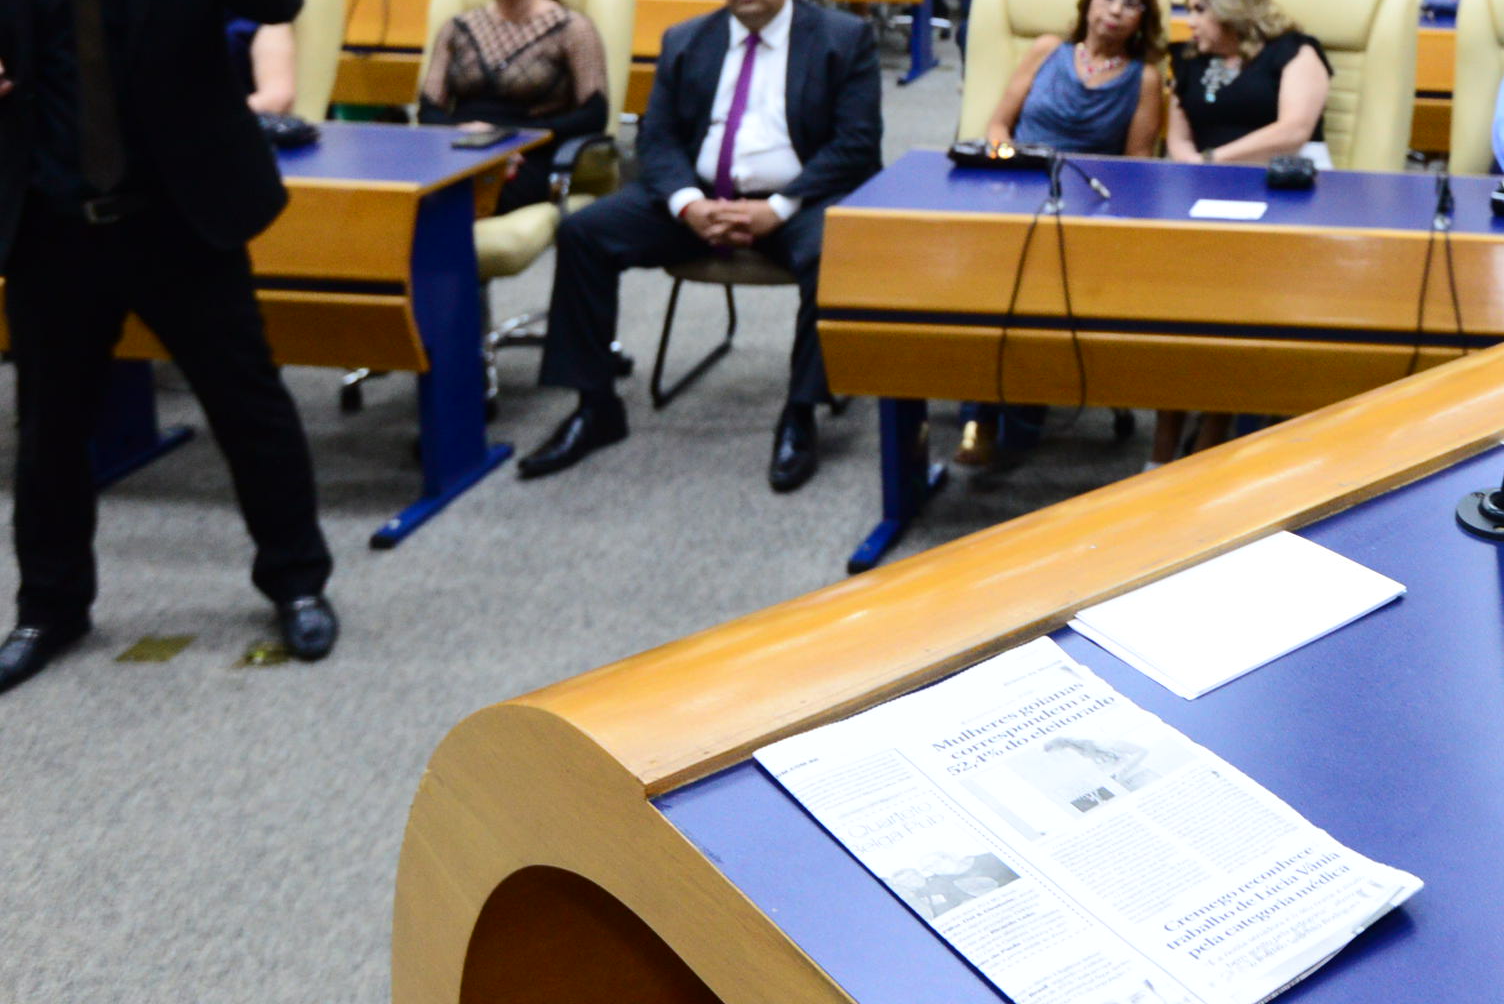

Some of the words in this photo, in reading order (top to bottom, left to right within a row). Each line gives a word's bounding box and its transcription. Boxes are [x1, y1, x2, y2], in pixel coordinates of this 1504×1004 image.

[932, 711, 1018, 753] Mulheres
[1018, 682, 1085, 717] goianas
[946, 747, 1005, 776] 52,4%
[1005, 735, 1030, 752] do
[1029, 694, 1115, 740] eleitorado
[951, 697, 1078, 760] correspondem
[1078, 692, 1092, 704] a
[1163, 888, 1239, 933] Cremego
[1238, 844, 1314, 895] reconhece
[1165, 907, 1236, 951] trabalho
[1235, 896, 1257, 913] de
[1256, 872, 1299, 904] Lúcia
[1296, 850, 1342, 878] Vânia
[1187, 933, 1226, 961] pela
[1225, 893, 1296, 938] categoria
[1295, 863, 1352, 899] médica
